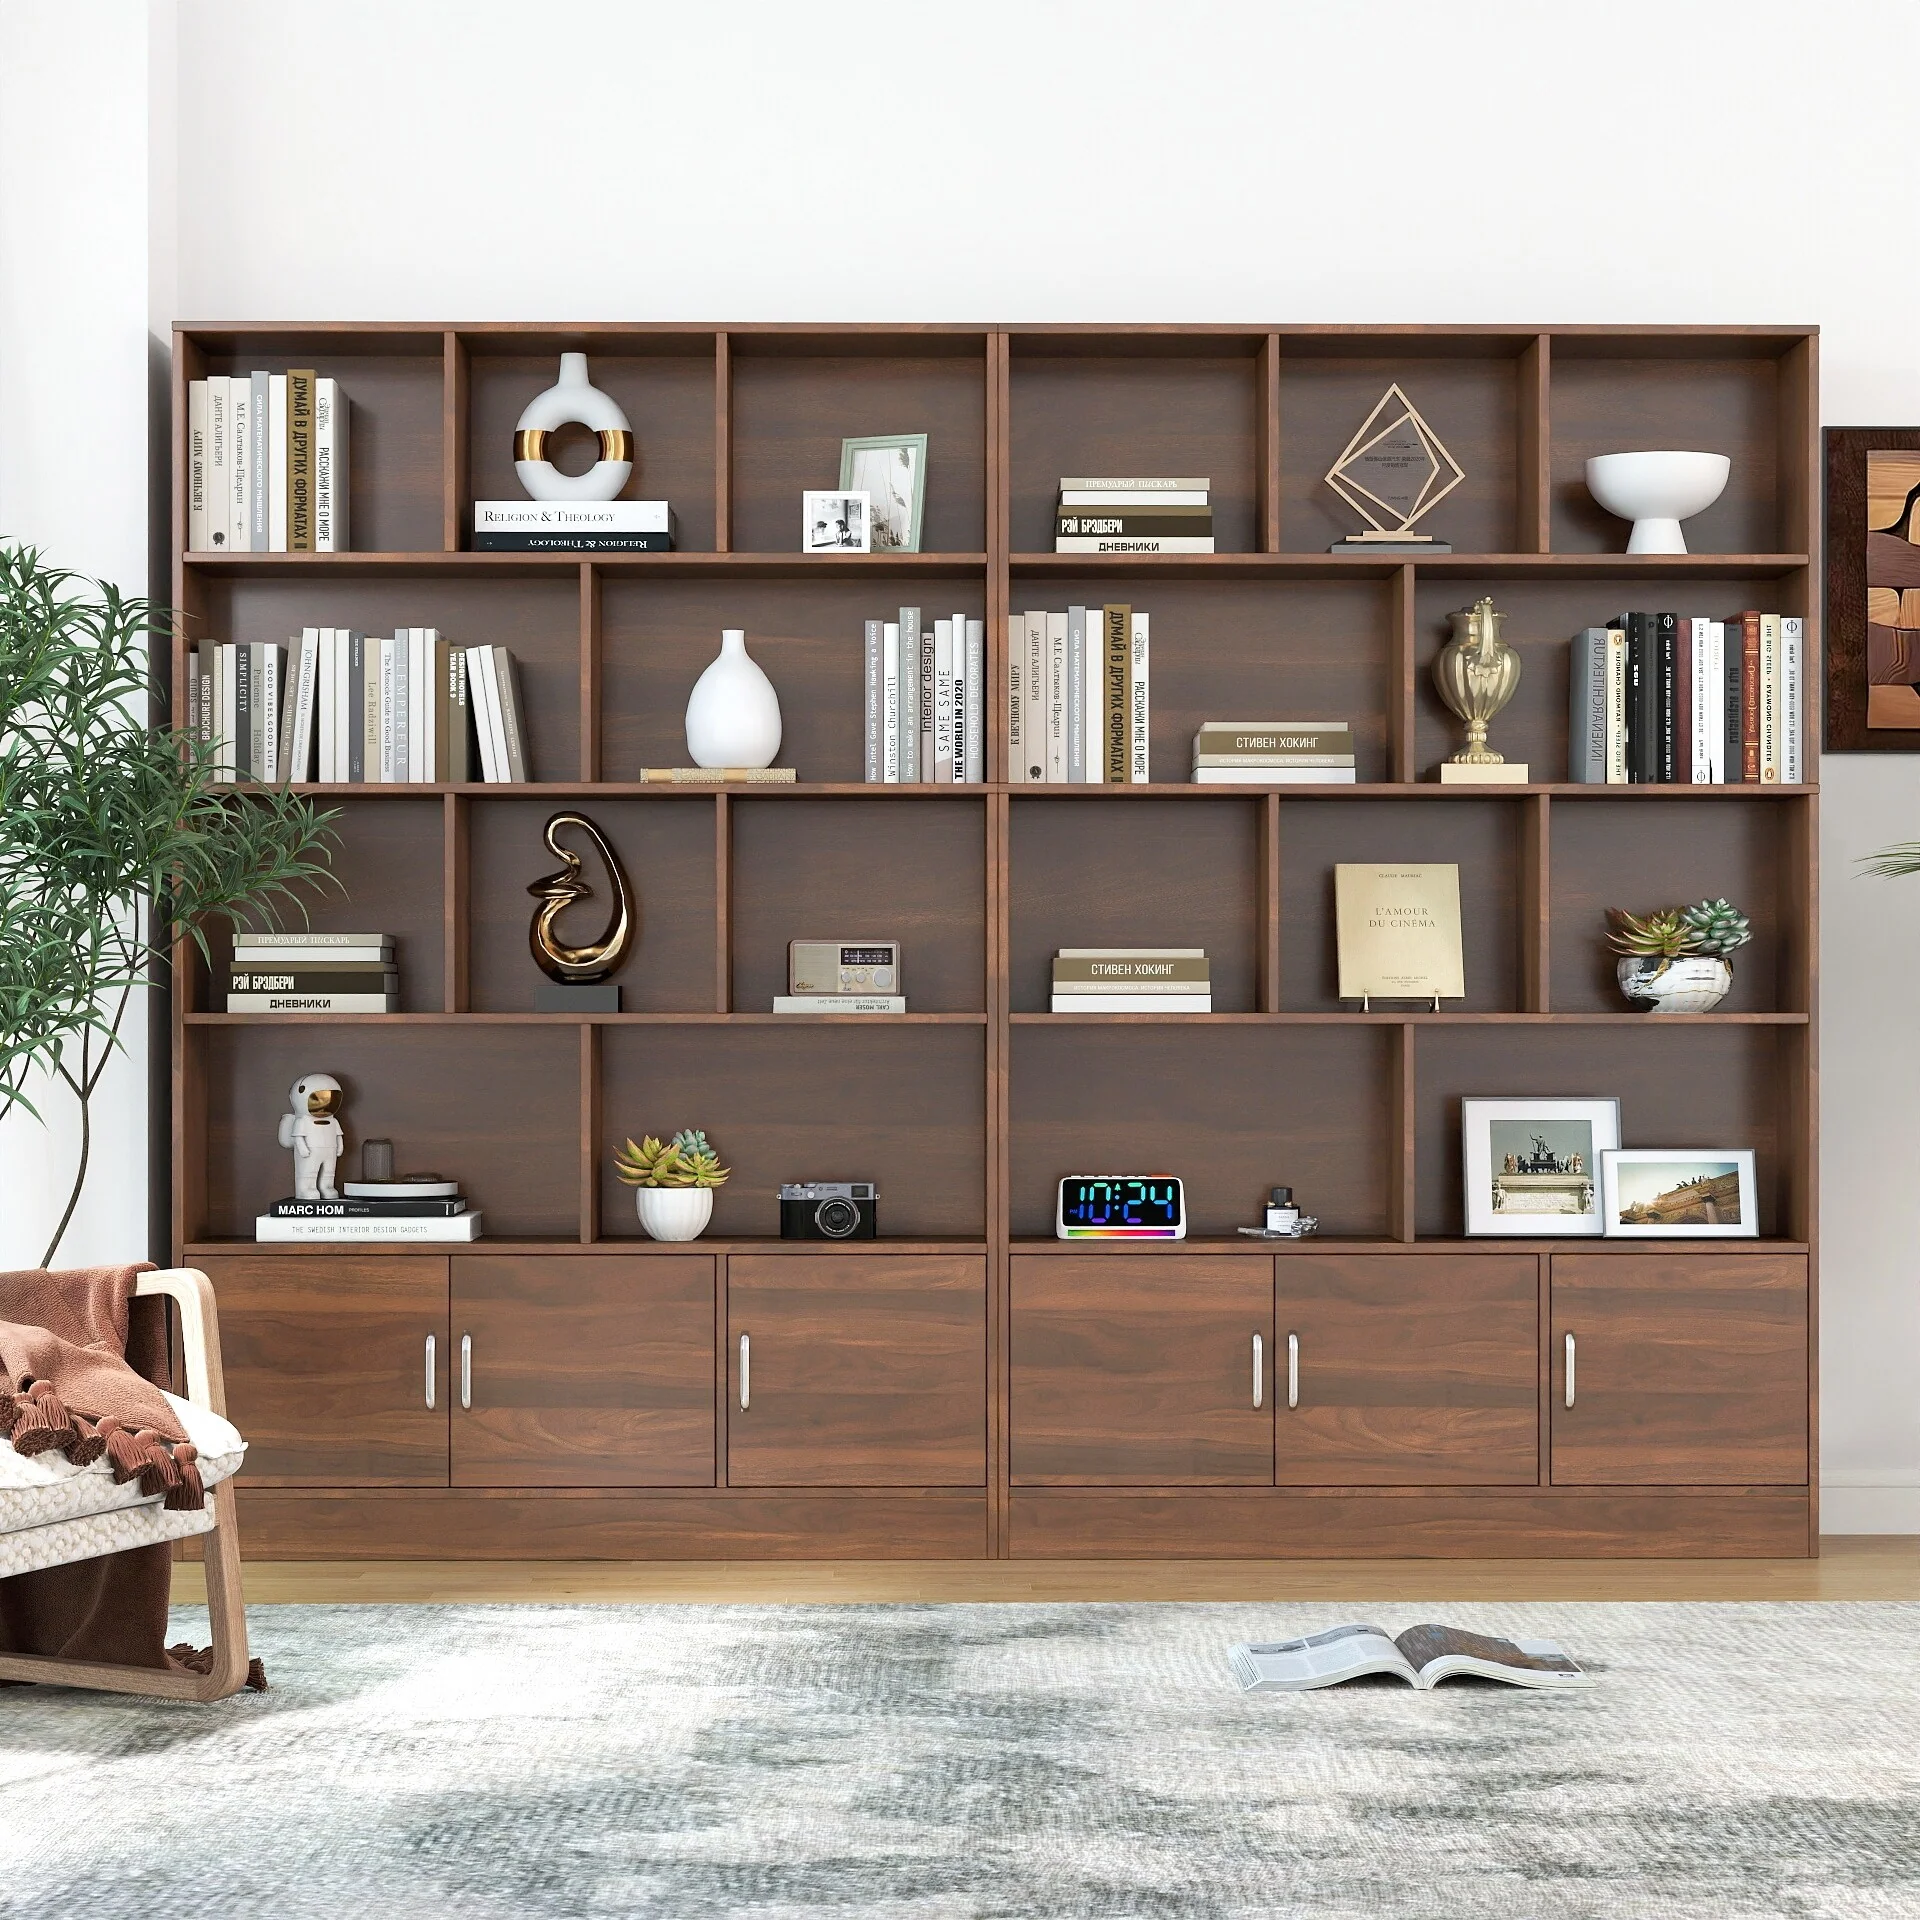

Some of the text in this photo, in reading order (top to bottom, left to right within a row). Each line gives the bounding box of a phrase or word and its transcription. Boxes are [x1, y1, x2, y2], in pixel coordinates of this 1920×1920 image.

[293, 376, 310, 417] ДУМАЙ
[193, 429, 203, 458] МИРУ
[214, 395, 223, 467] ДАНТЕ АЛИГЬЕРИ
[234, 402, 245, 504] М.Е. Салтыков-Щедрин
[293, 430, 308, 475] ДРУГИХ
[193, 460, 203, 503] ВЕЧНОМУ
[318, 447, 329, 490] РАССКАЖИ
[294, 478, 308, 539] ФОРМАТАХ
[318, 492, 329, 509] МНЕ
[318, 519, 329, 541] МОРЕ
[484, 511, 615, 522] RELIGION & THEOLOGY
[1061, 516, 1123, 534] РЭЙ БРЭДБЕРИ
[528, 539, 648, 549] RELIGION & THEOLOGY
[1098, 542, 1160, 552] ДНЕВНИКИ
[1110, 611, 1126, 651] ДУМАЙ
[384, 652, 392, 666] The
[870, 656, 878, 687] Hawking
[907, 653, 914, 662] in
[1031, 630, 1039, 701] ДАНТЕ АЛИГЬЕРИ
[201, 675, 211, 700] DESIGN
[239, 652, 247, 712] SIMPLICITY
[384, 668, 392, 696] Monocle
[921, 637, 934, 733] Interior design
[1011, 663, 1020, 693] МИРУ
[1051, 637, 1062, 738] М.Е. Салтыков-Щедрин
[1110, 666, 1123, 709] ДРУГИХ
[368, 681, 377, 744] Lee Radziwill
[384, 696, 392, 716] Guide
[396, 664, 407, 765] LEMPEREUR
[870, 689, 878, 719] Stephen
[938, 670, 950, 752] SAME SAME
[970, 642, 979, 759] HOUSEHOLD DECORATES
[1134, 681, 1145, 724] РАССКАЖИ
[888, 675, 896, 777] Winston Churchill
[909, 716, 914, 726] an
[955, 679, 964, 779] THE WORLD IN 2020
[1011, 695, 1020, 738] ВЕЧНОМУ
[252, 729, 261, 764] Holiday
[384, 725, 392, 744] Good
[1111, 713, 1123, 773] ФОРМАТАХ
[1134, 726, 1145, 743] МНЕ
[1236, 737, 1319, 748] СТИВЕН ХОКИНГ
[384, 745, 392, 772] Business
[1134, 753, 1145, 775] МОРЕ
[1369, 918, 1436, 928] DU CINÉMA
[1375, 907, 1429, 916] L'AMOUR
[232, 973, 295, 991] РЭЙ БРЭДБЕРИ
[1091, 964, 1175, 975] СТИВЕН ХОКИНГ
[269, 999, 331, 1009] ДНЕВНИКИ
[278, 1205, 314, 1215] MARC
[316, 1205, 344, 1215] HOM
[1079, 1182, 1173, 1224] 10:24
